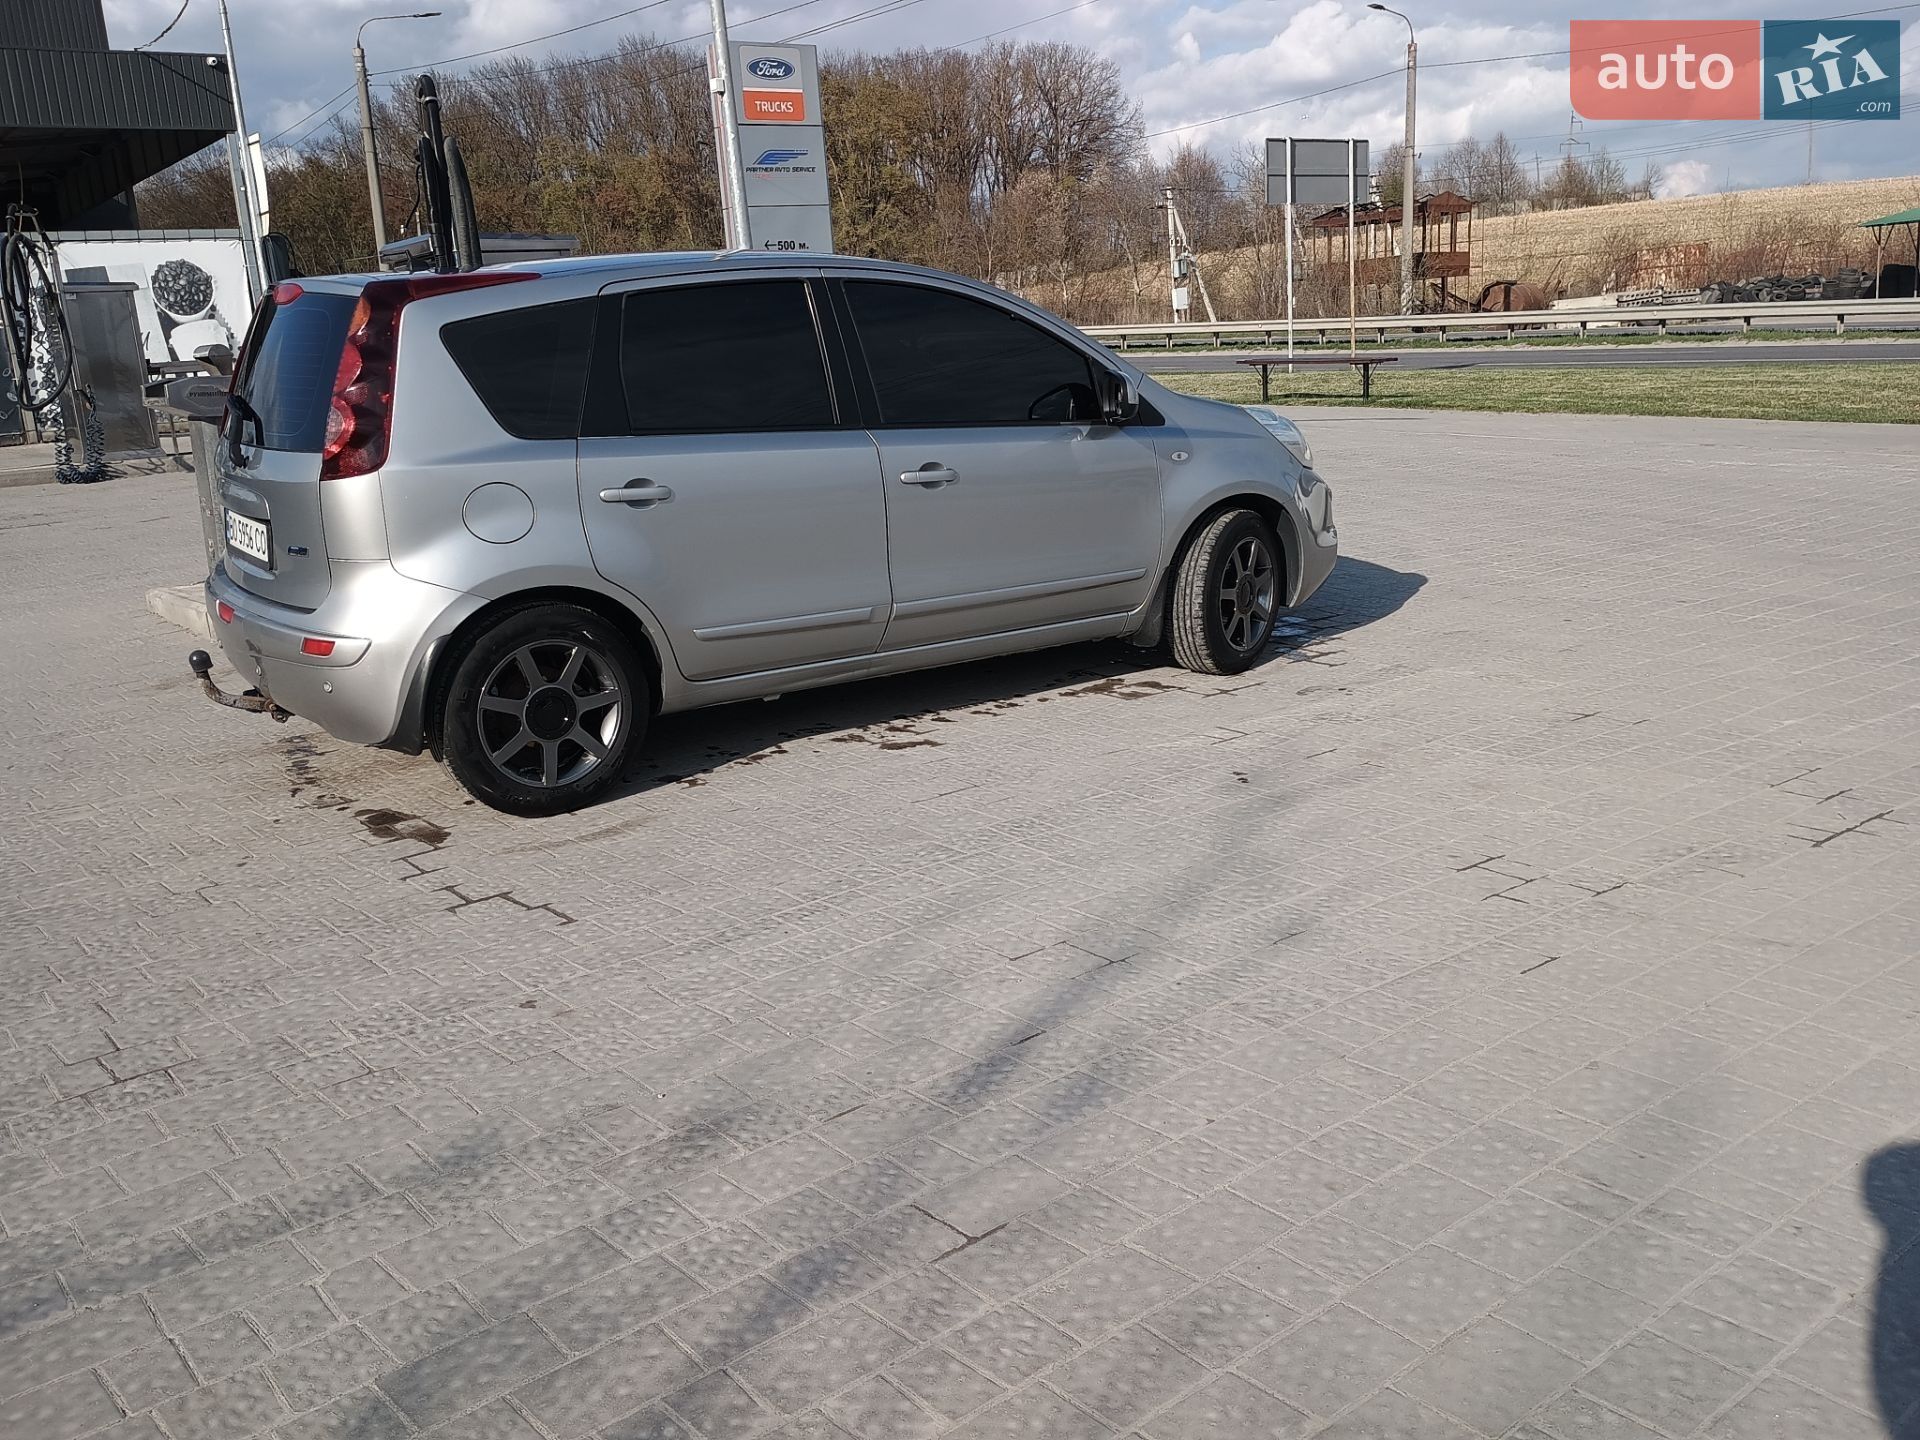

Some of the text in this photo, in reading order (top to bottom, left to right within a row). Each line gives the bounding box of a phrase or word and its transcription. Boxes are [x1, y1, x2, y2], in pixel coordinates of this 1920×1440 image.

[757, 60, 786, 76] Ford
[754, 100, 794, 113] TRUCKS
[777, 240, 796, 251] 500
